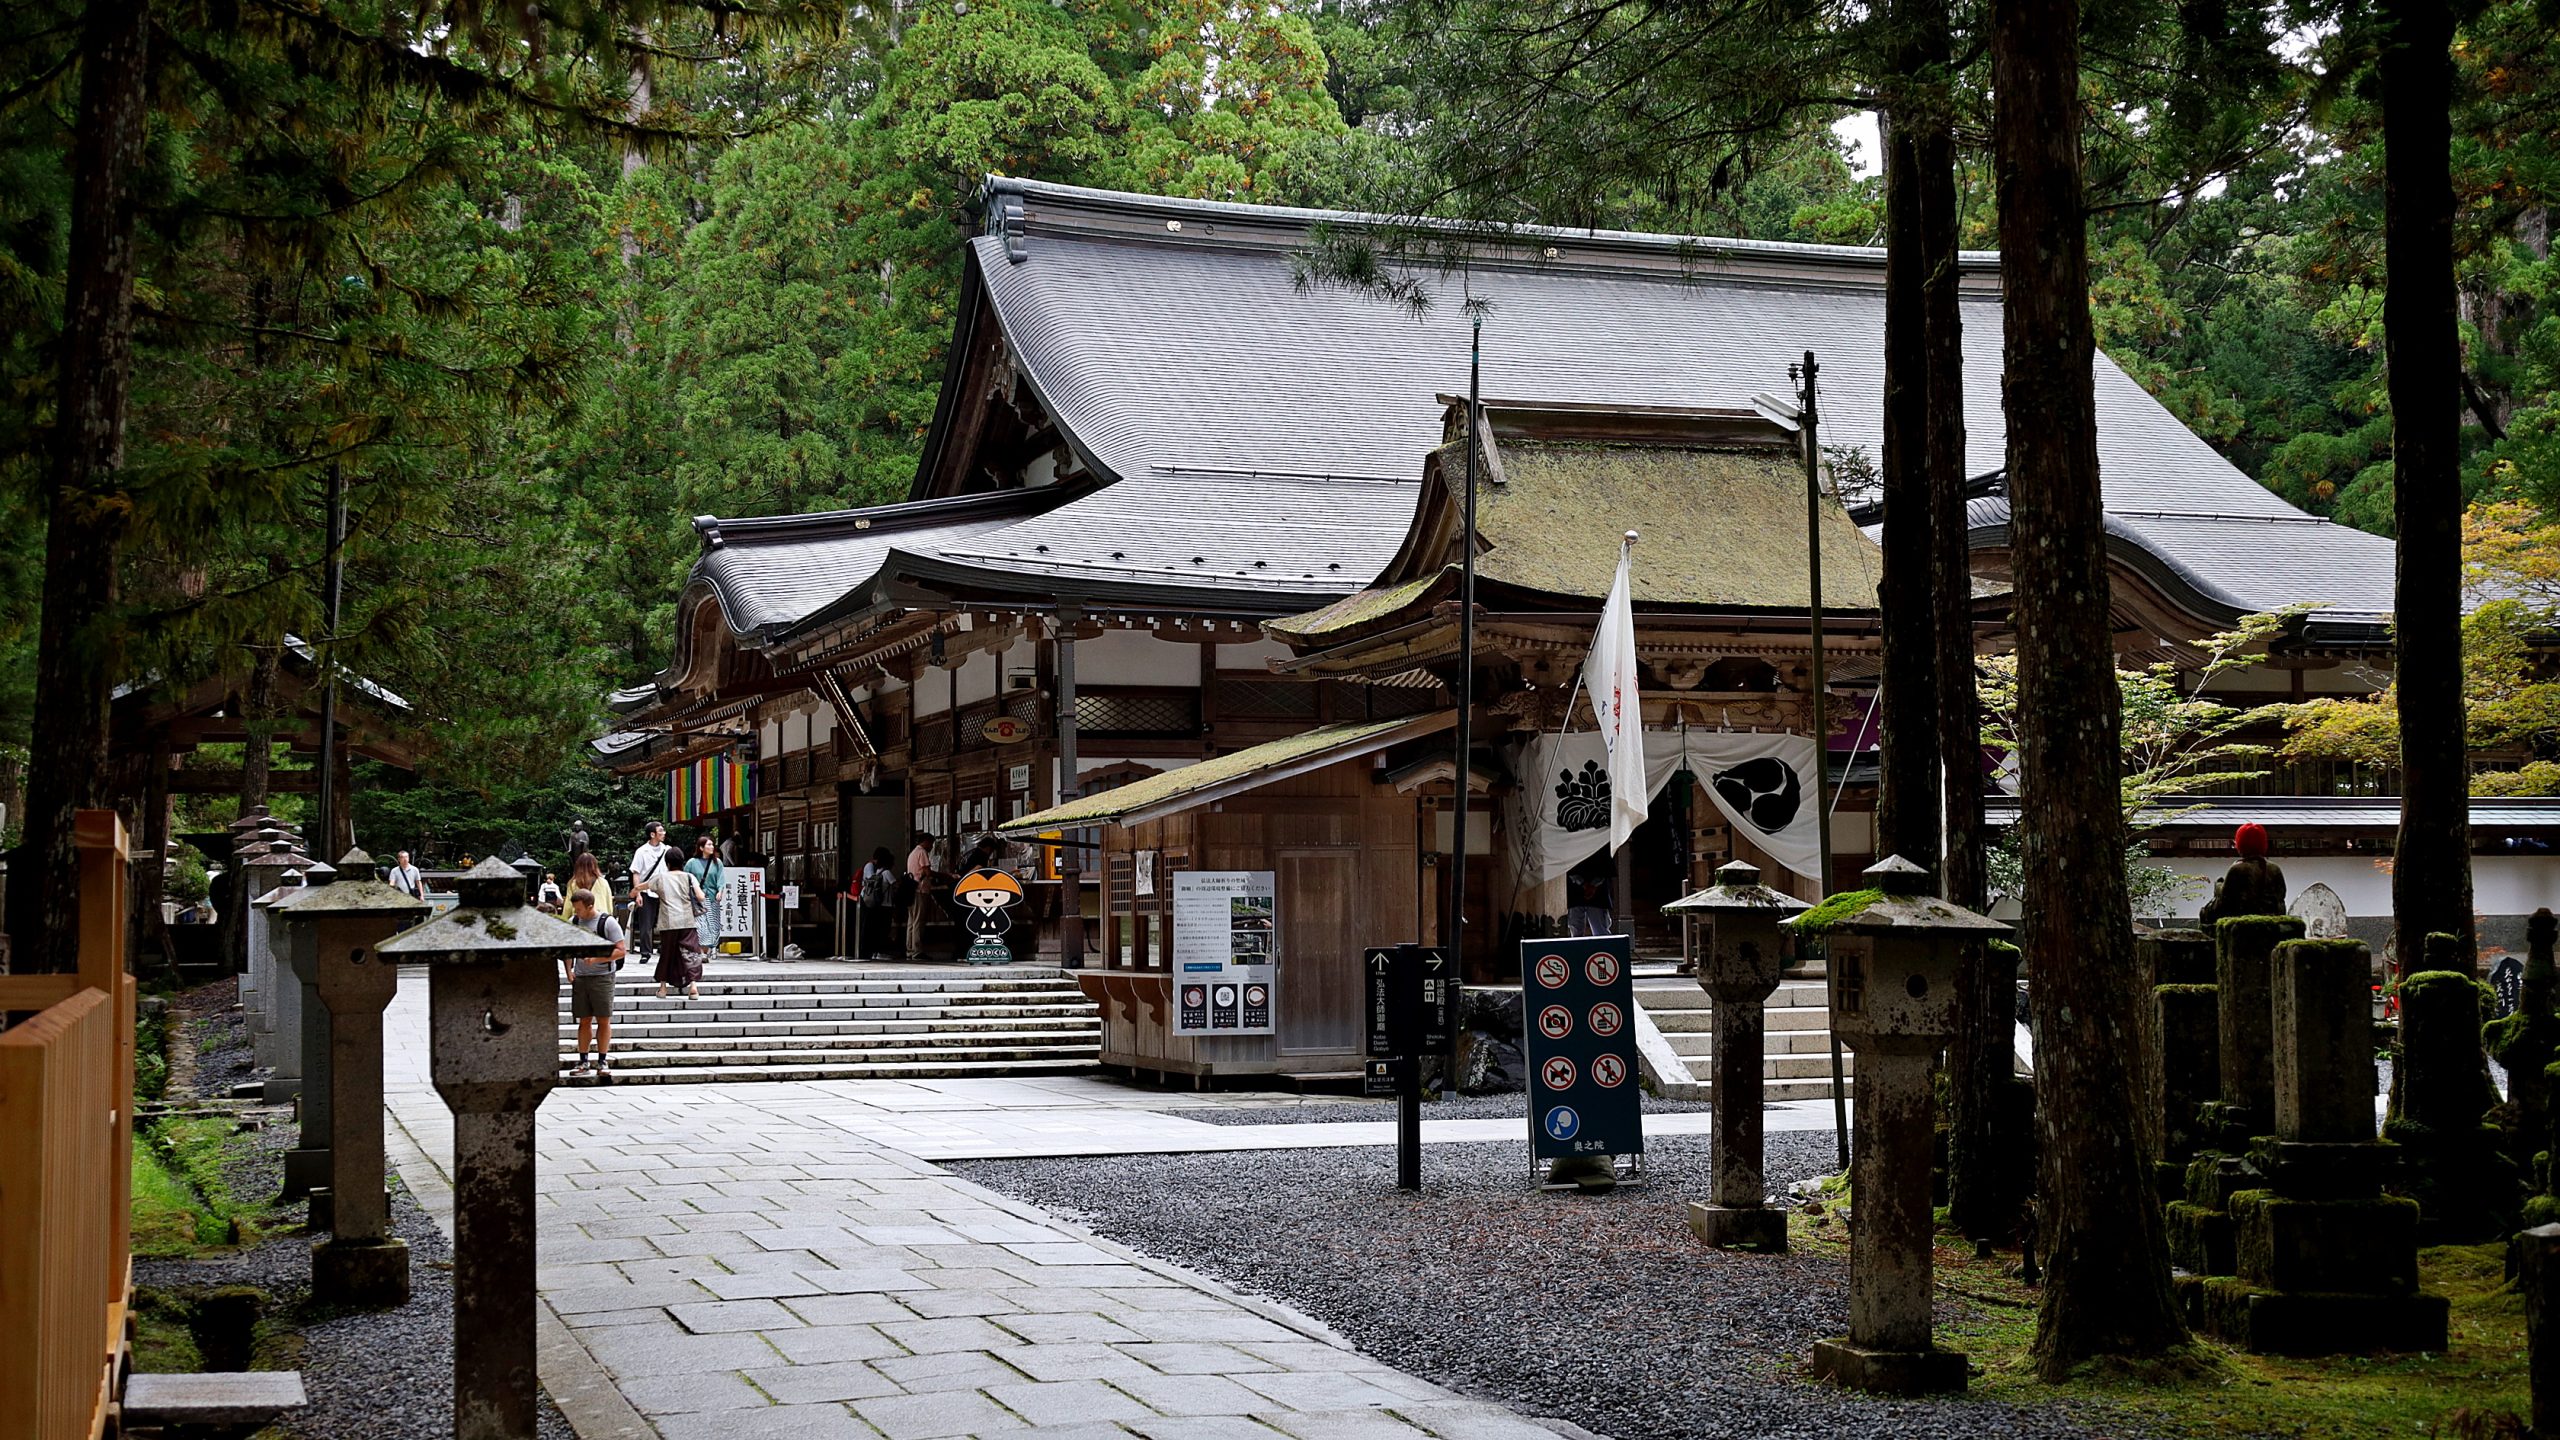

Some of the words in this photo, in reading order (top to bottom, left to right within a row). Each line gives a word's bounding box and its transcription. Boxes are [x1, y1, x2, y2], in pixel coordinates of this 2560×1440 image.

[737, 874, 748, 932] ご注意下さい
[1574, 1139, 1605, 1152] 奥之院
